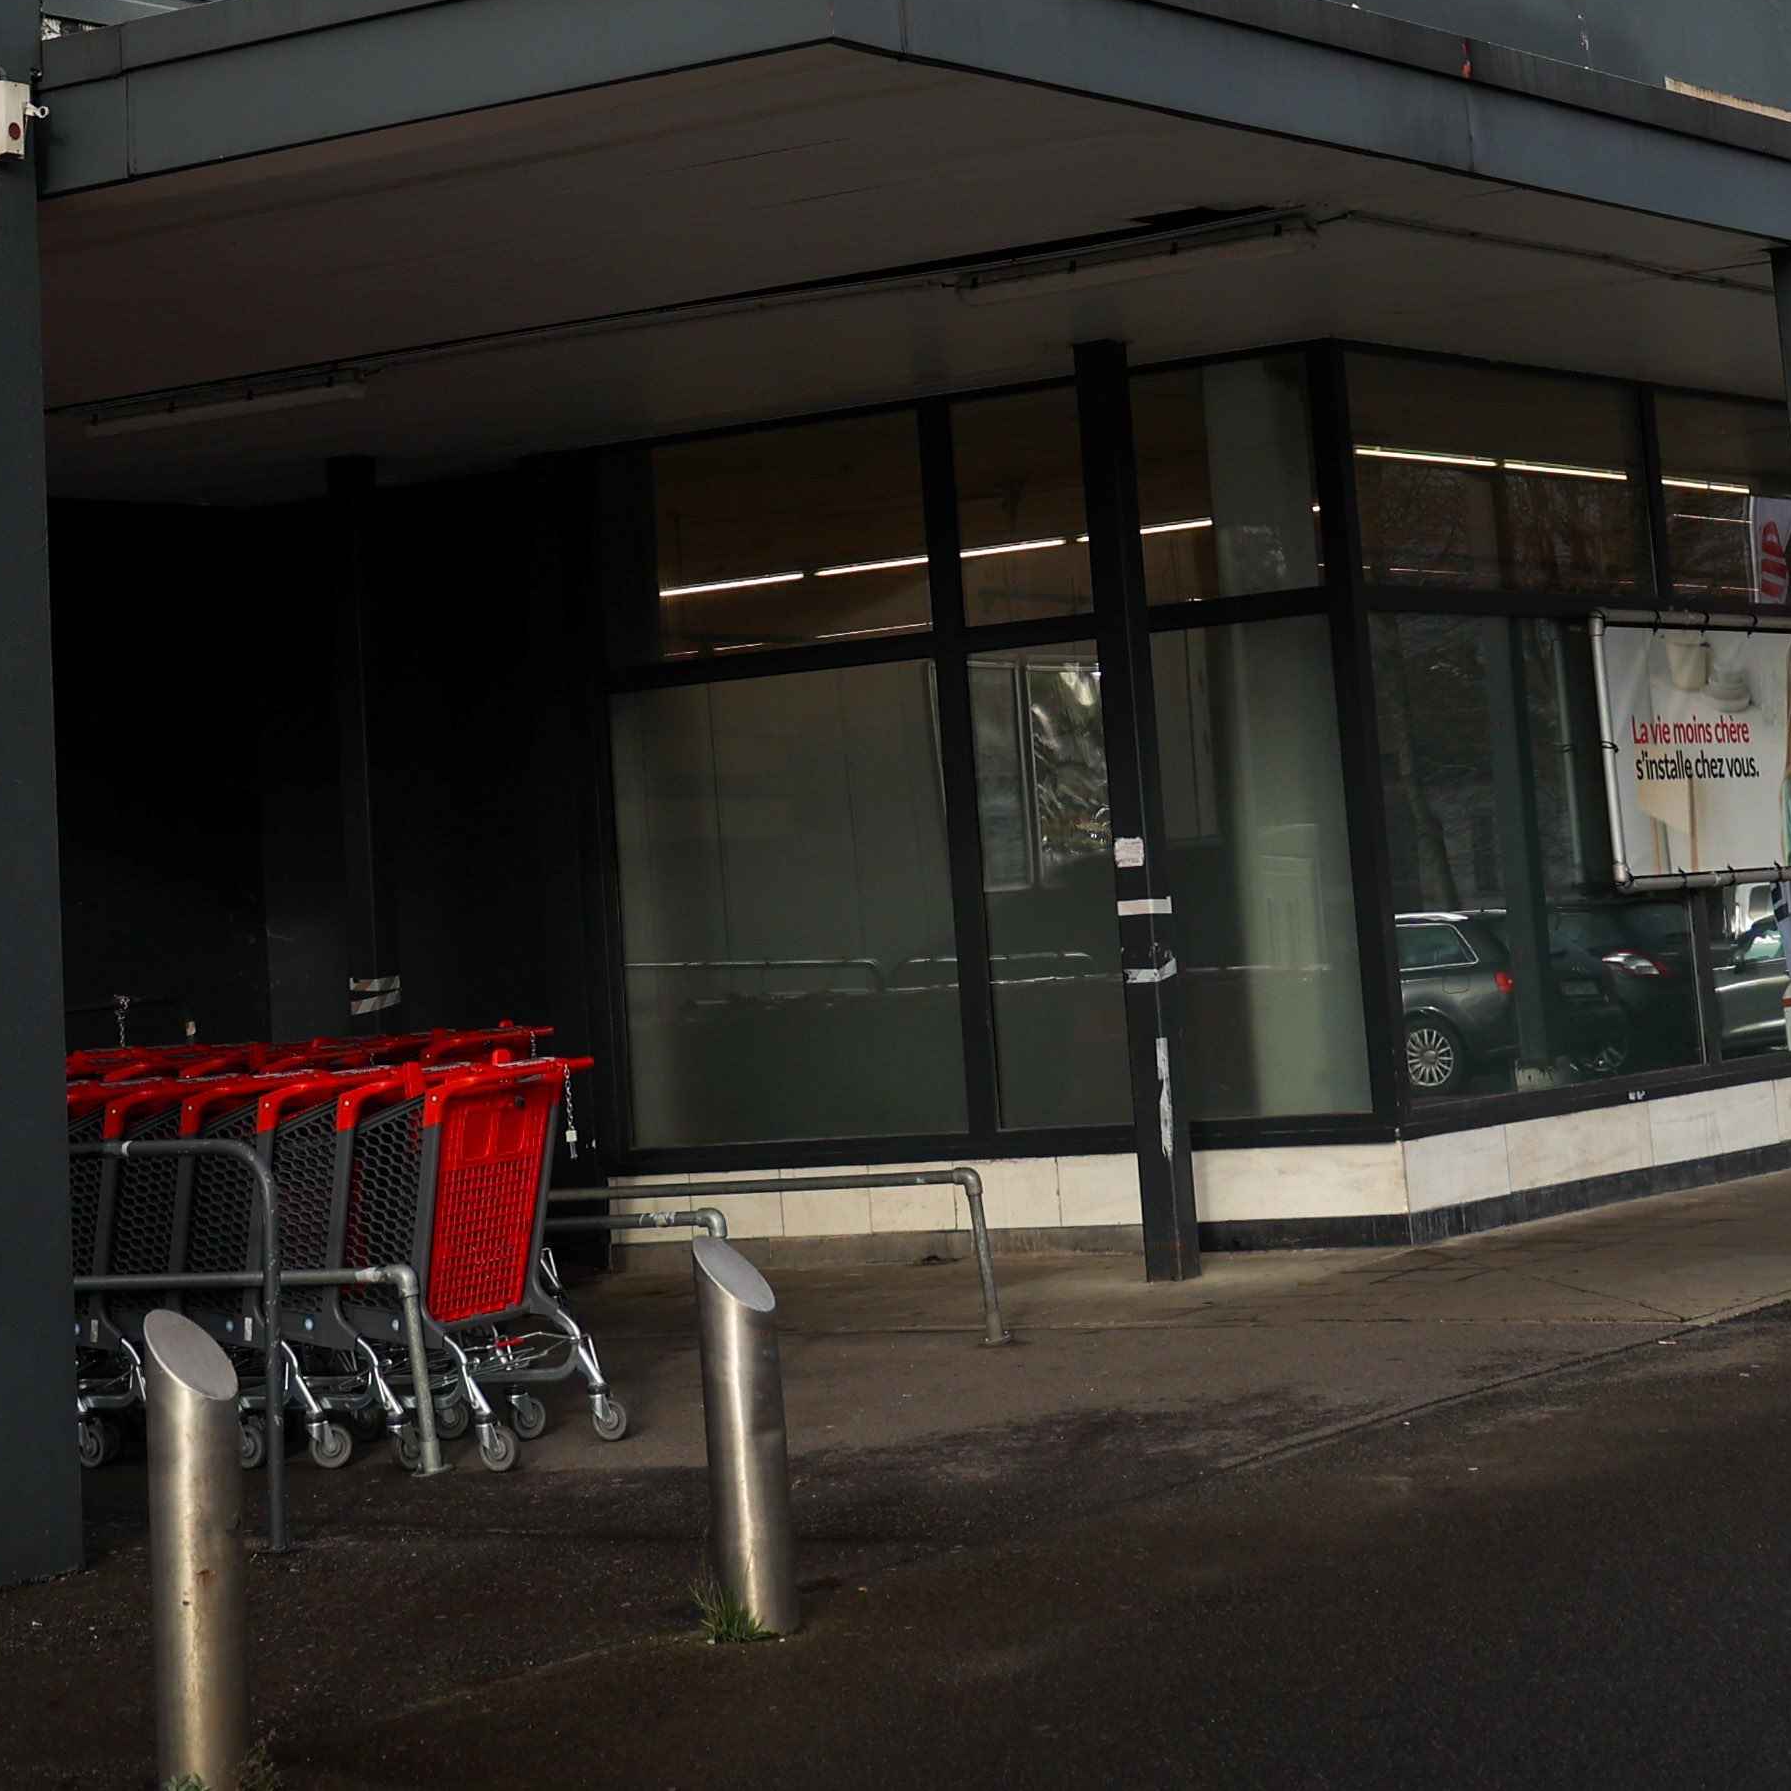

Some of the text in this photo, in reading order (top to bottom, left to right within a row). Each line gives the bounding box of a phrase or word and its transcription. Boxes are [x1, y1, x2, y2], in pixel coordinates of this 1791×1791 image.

[1631, 716, 1750, 744] La vie moins chère
[1694, 753, 1726, 780] chez
[1727, 757, 1760, 779] vous.
